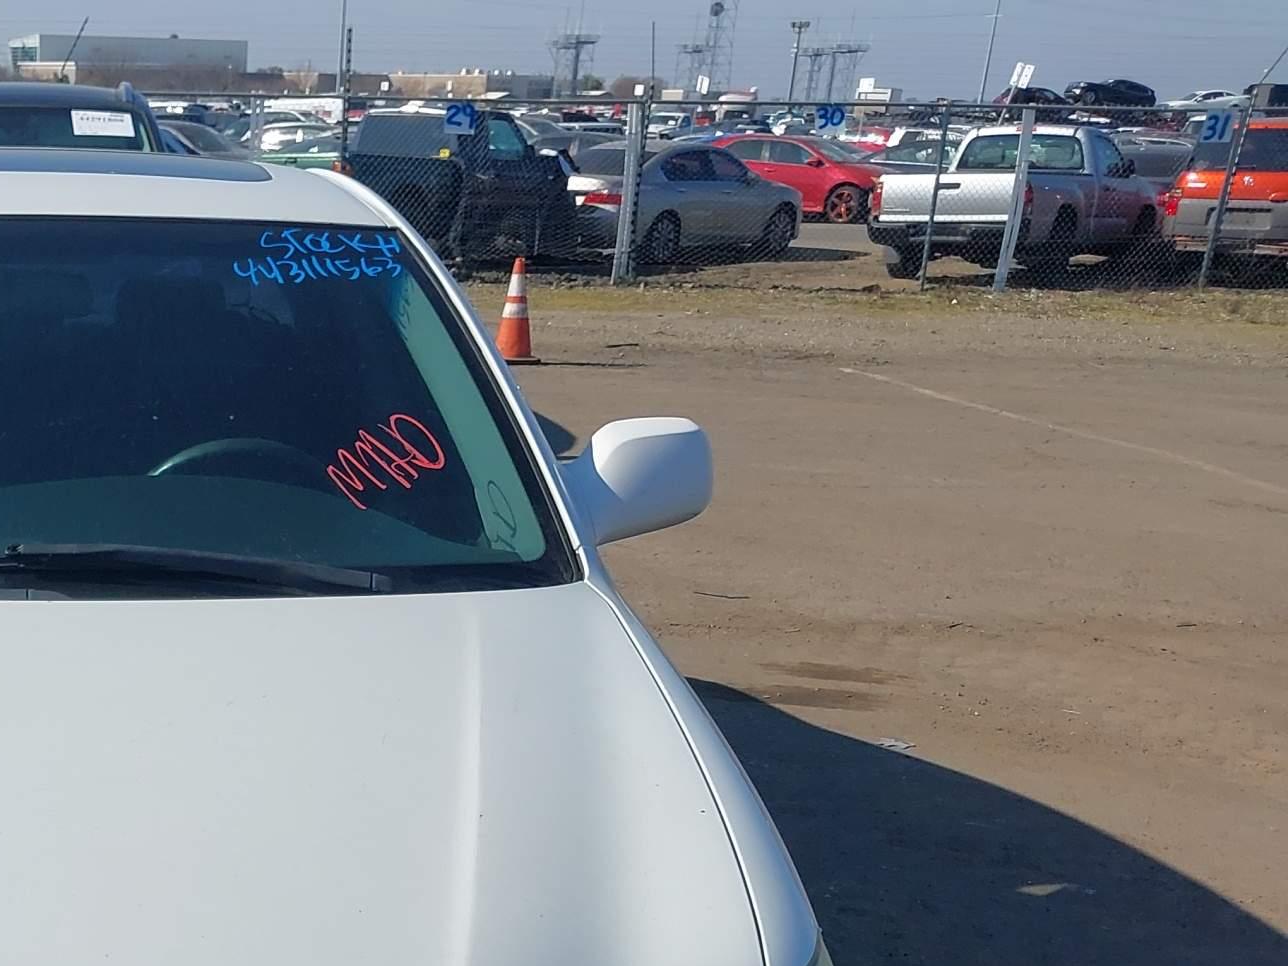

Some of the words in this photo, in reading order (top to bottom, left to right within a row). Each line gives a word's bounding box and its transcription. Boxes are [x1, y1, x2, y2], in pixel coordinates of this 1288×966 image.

[446, 103, 476, 129] 29
[816, 106, 845, 129] 30
[1202, 113, 1232, 141] 31
